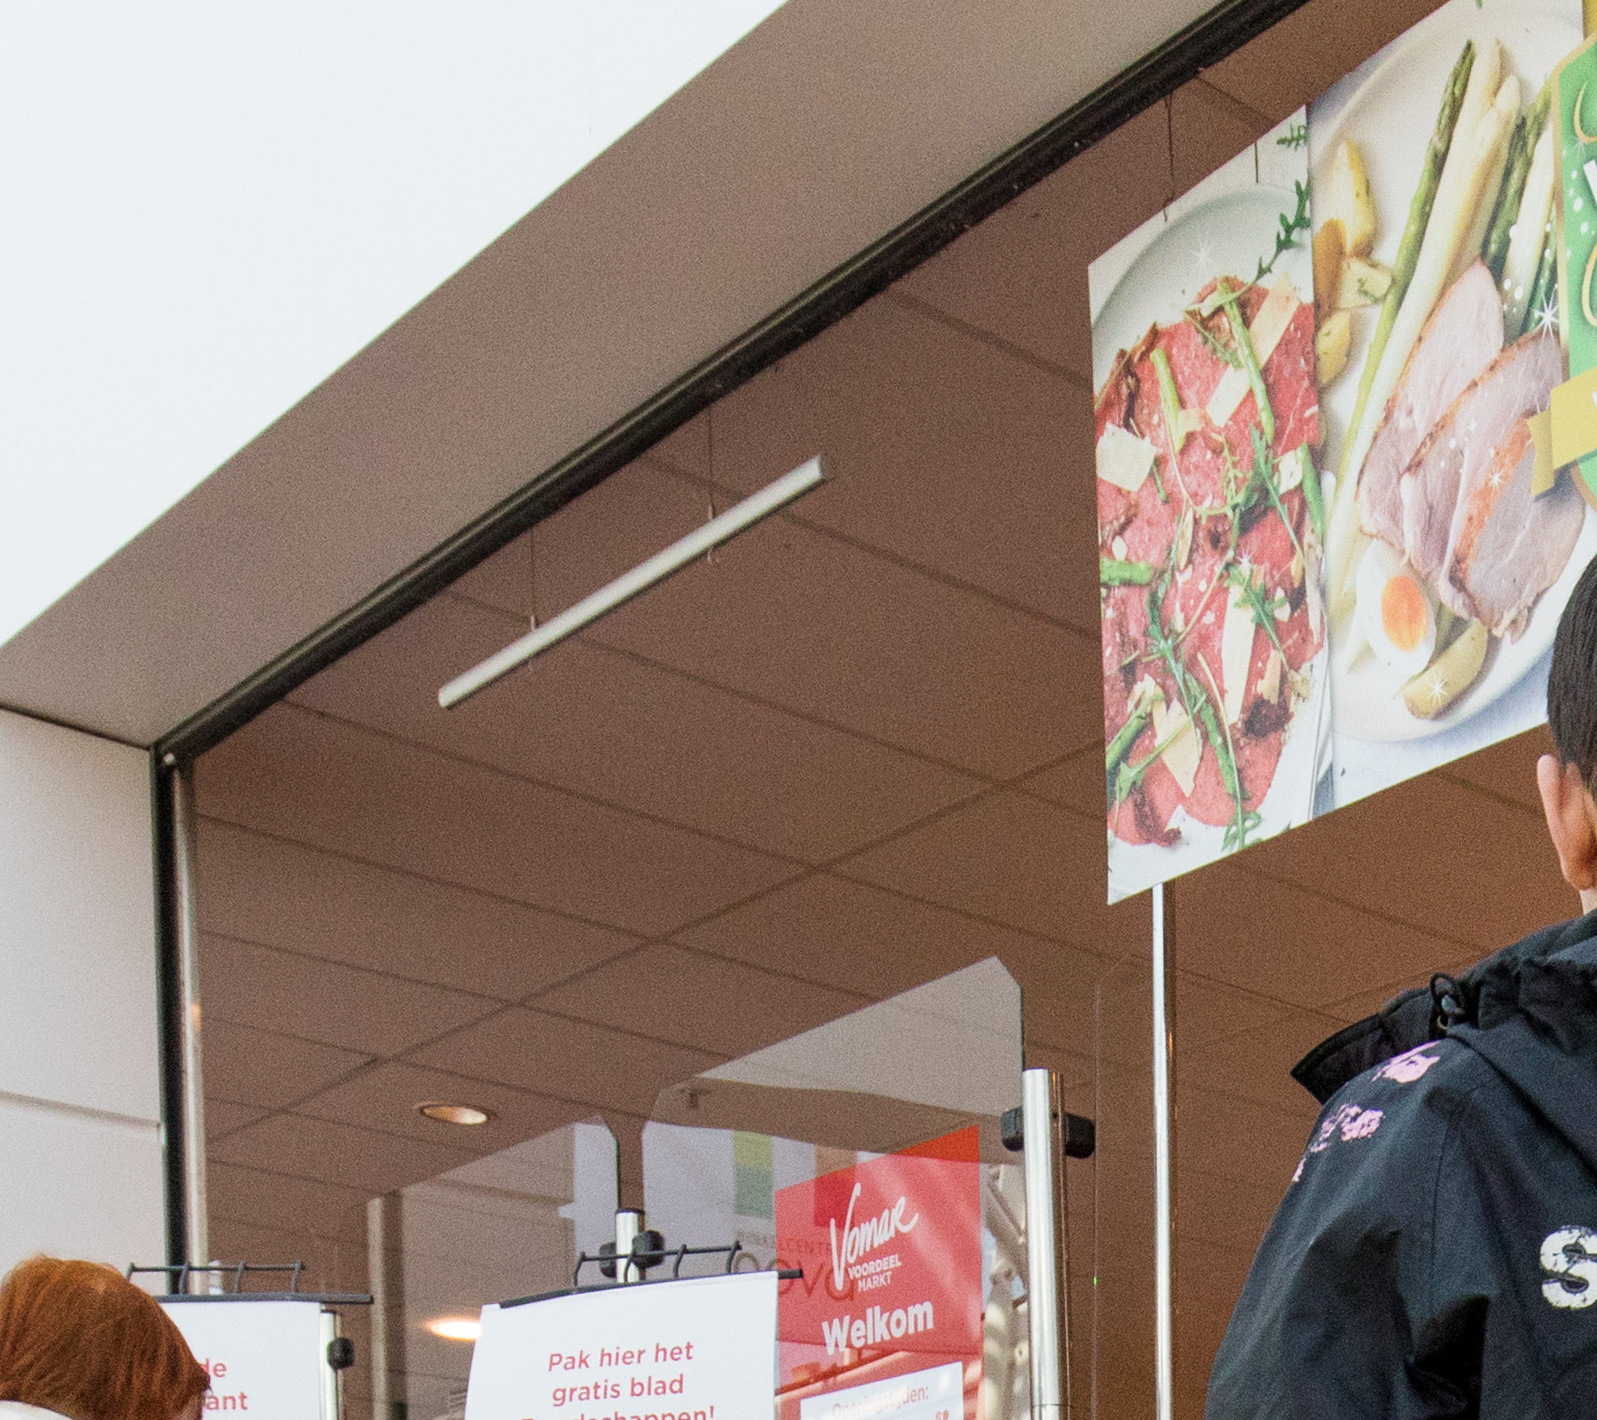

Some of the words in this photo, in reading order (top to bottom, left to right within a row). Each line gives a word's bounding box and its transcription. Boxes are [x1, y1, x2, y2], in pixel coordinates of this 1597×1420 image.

[830, 1182, 919, 1291] Vomar
[848, 1253, 902, 1281] VOORDEEL
[858, 1271, 893, 1292] MARKT
[821, 1301, 934, 1355] Welkom
[548, 1350, 591, 1372] Pak
[599, 1346, 646, 1368] hier
[654, 1341, 694, 1363] het
[204, 1391, 248, 1411] ant
[552, 1379, 621, 1407] gratis
[630, 1373, 684, 1397] blad
